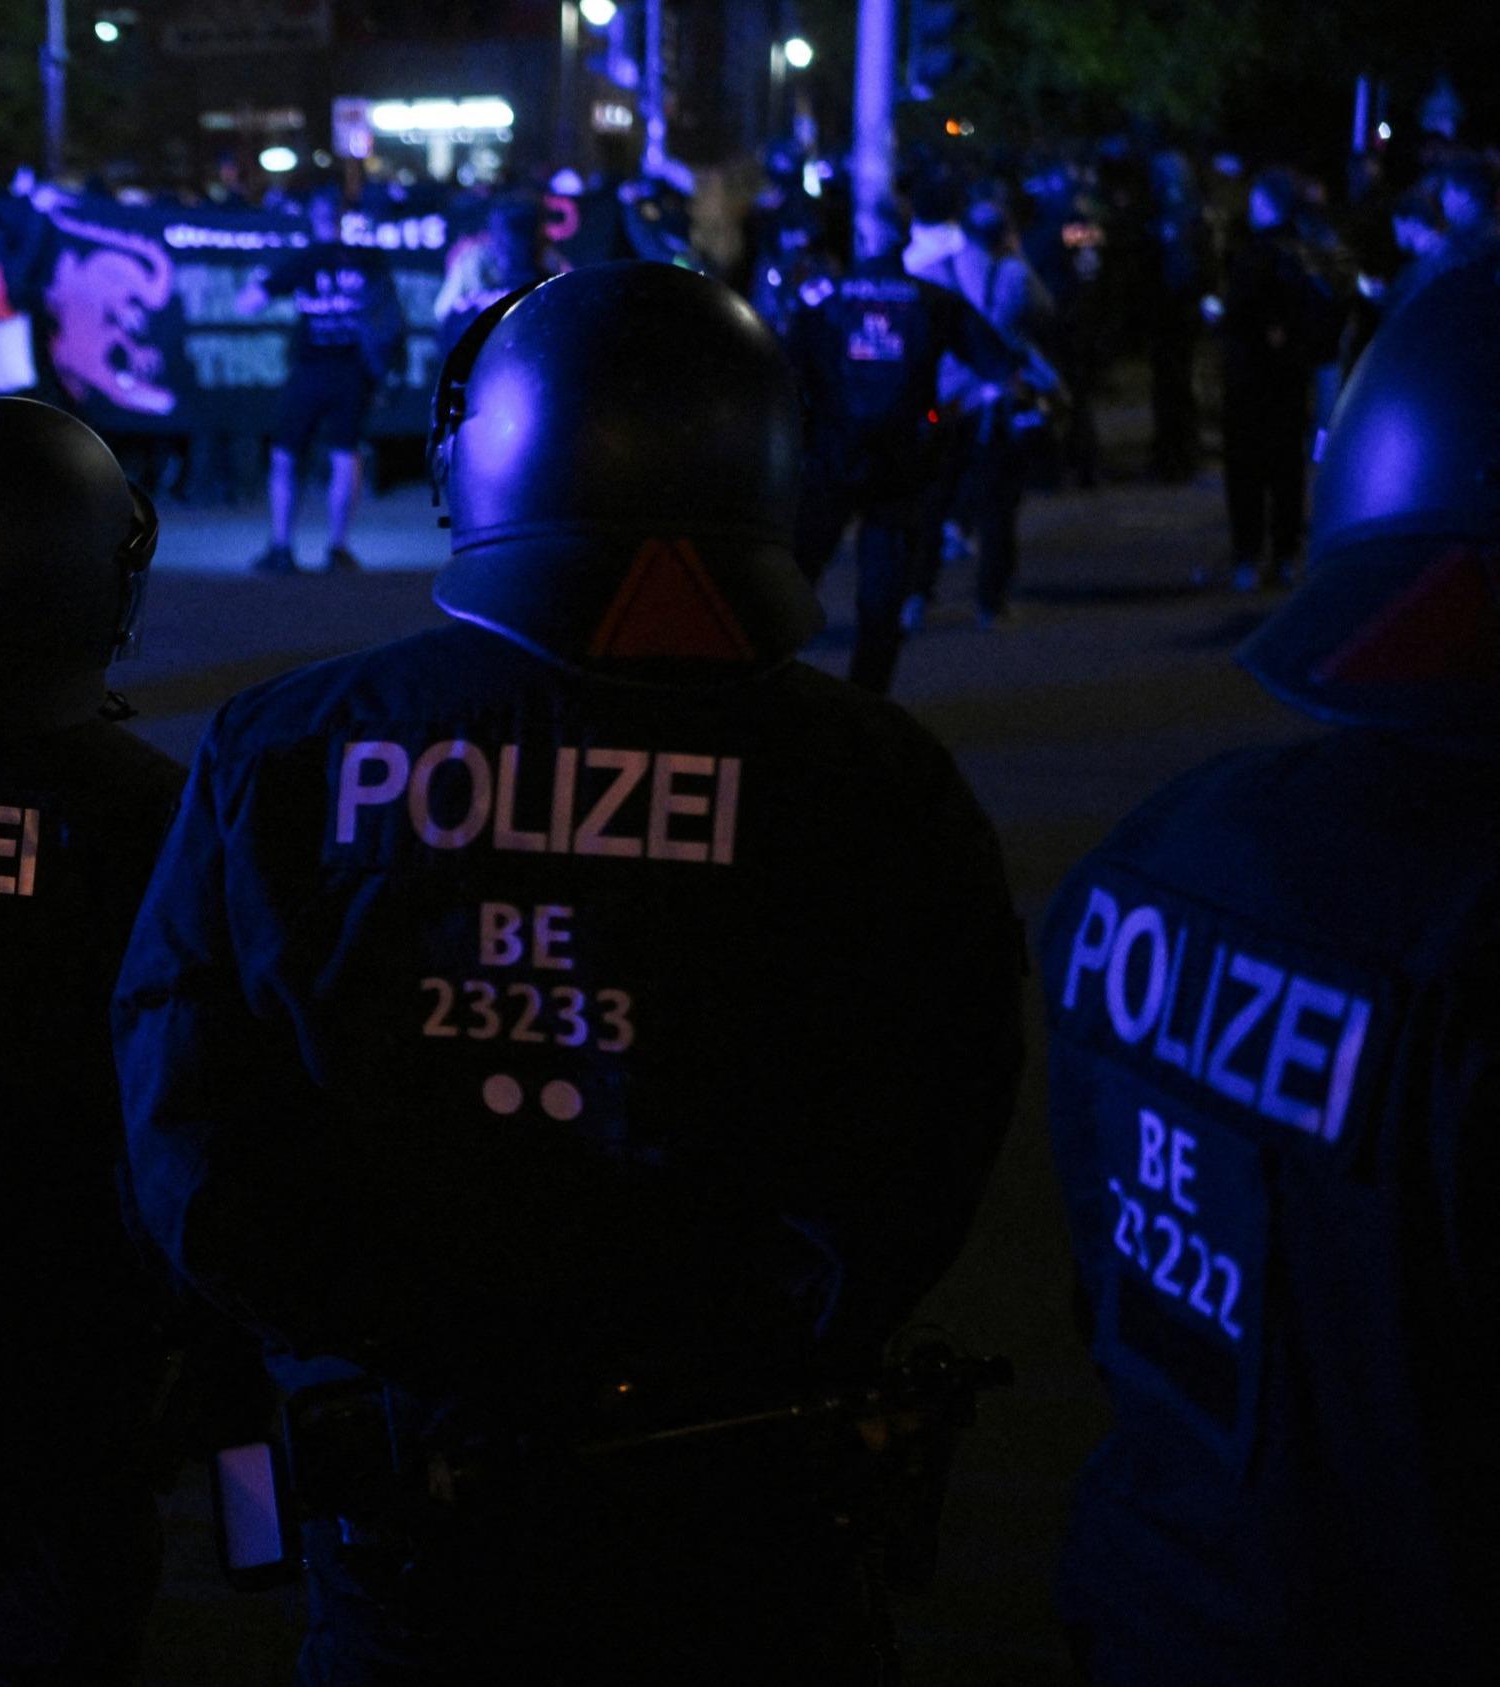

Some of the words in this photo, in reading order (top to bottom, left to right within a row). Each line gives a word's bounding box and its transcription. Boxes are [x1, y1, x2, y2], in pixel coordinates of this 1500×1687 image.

[335, 739, 742, 866] POLIZEI
[478, 902, 575, 971] BE
[420, 976, 636, 1053] 23233
[1061, 886, 1373, 1144] POLIZEI
[1137, 1107, 1199, 1215] BE
